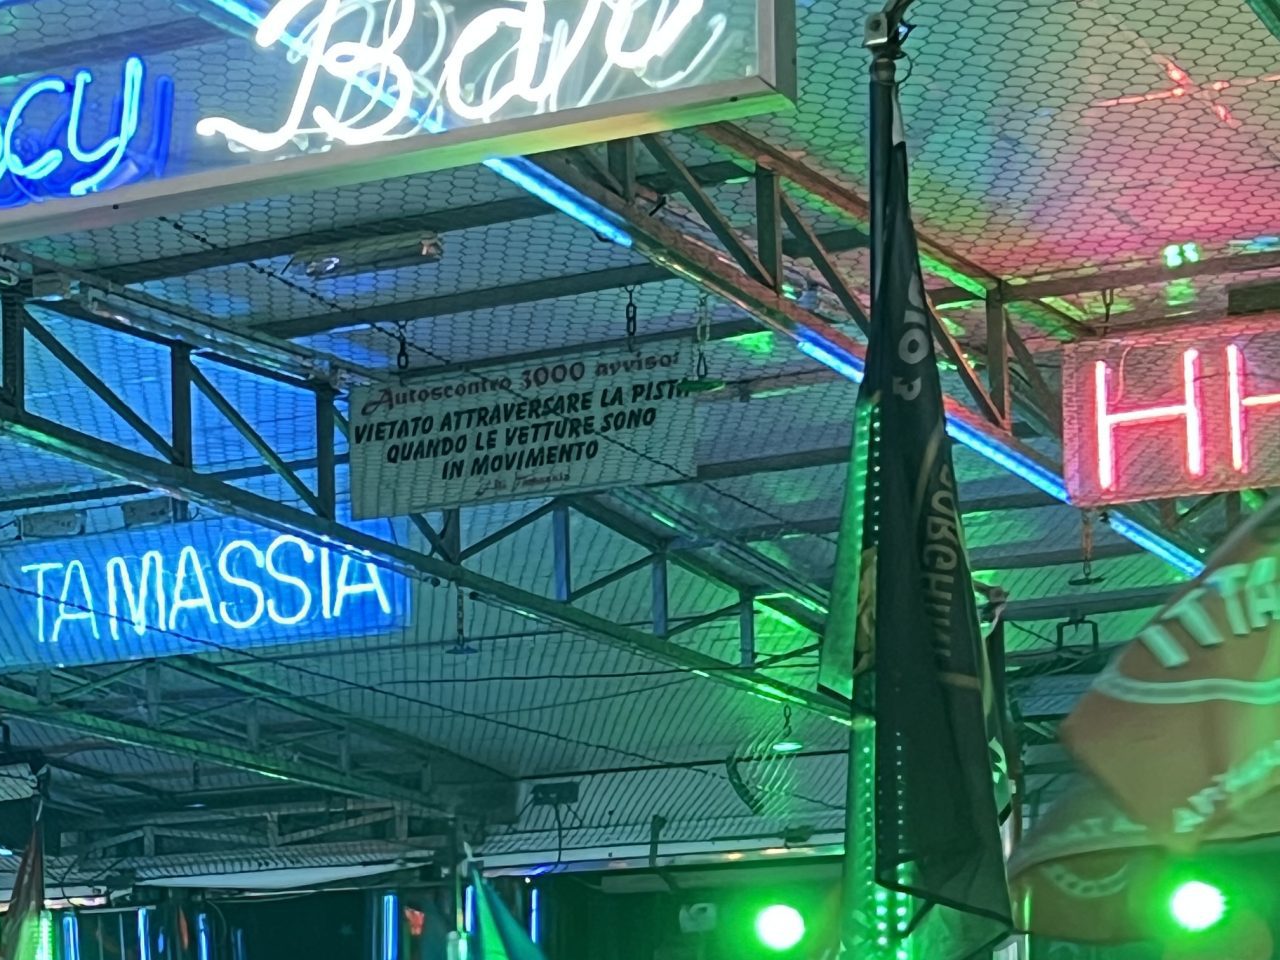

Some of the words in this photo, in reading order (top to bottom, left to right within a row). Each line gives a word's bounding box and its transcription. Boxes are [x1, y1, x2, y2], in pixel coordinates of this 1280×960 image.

[521, 361, 586, 390] 3000
[355, 416, 434, 444] VIETATO
[440, 391, 594, 432] ATTRAVERSARE
[601, 387, 624, 408] LA
[387, 434, 467, 463] QUANDO
[476, 430, 498, 450] LE
[505, 415, 595, 447] VETTURE
[601, 407, 657, 433] SONO
[442, 460, 464, 480] IN
[471, 439, 599, 476] MOVIMENTO
[21, 534, 392, 643] TAMASSIA
